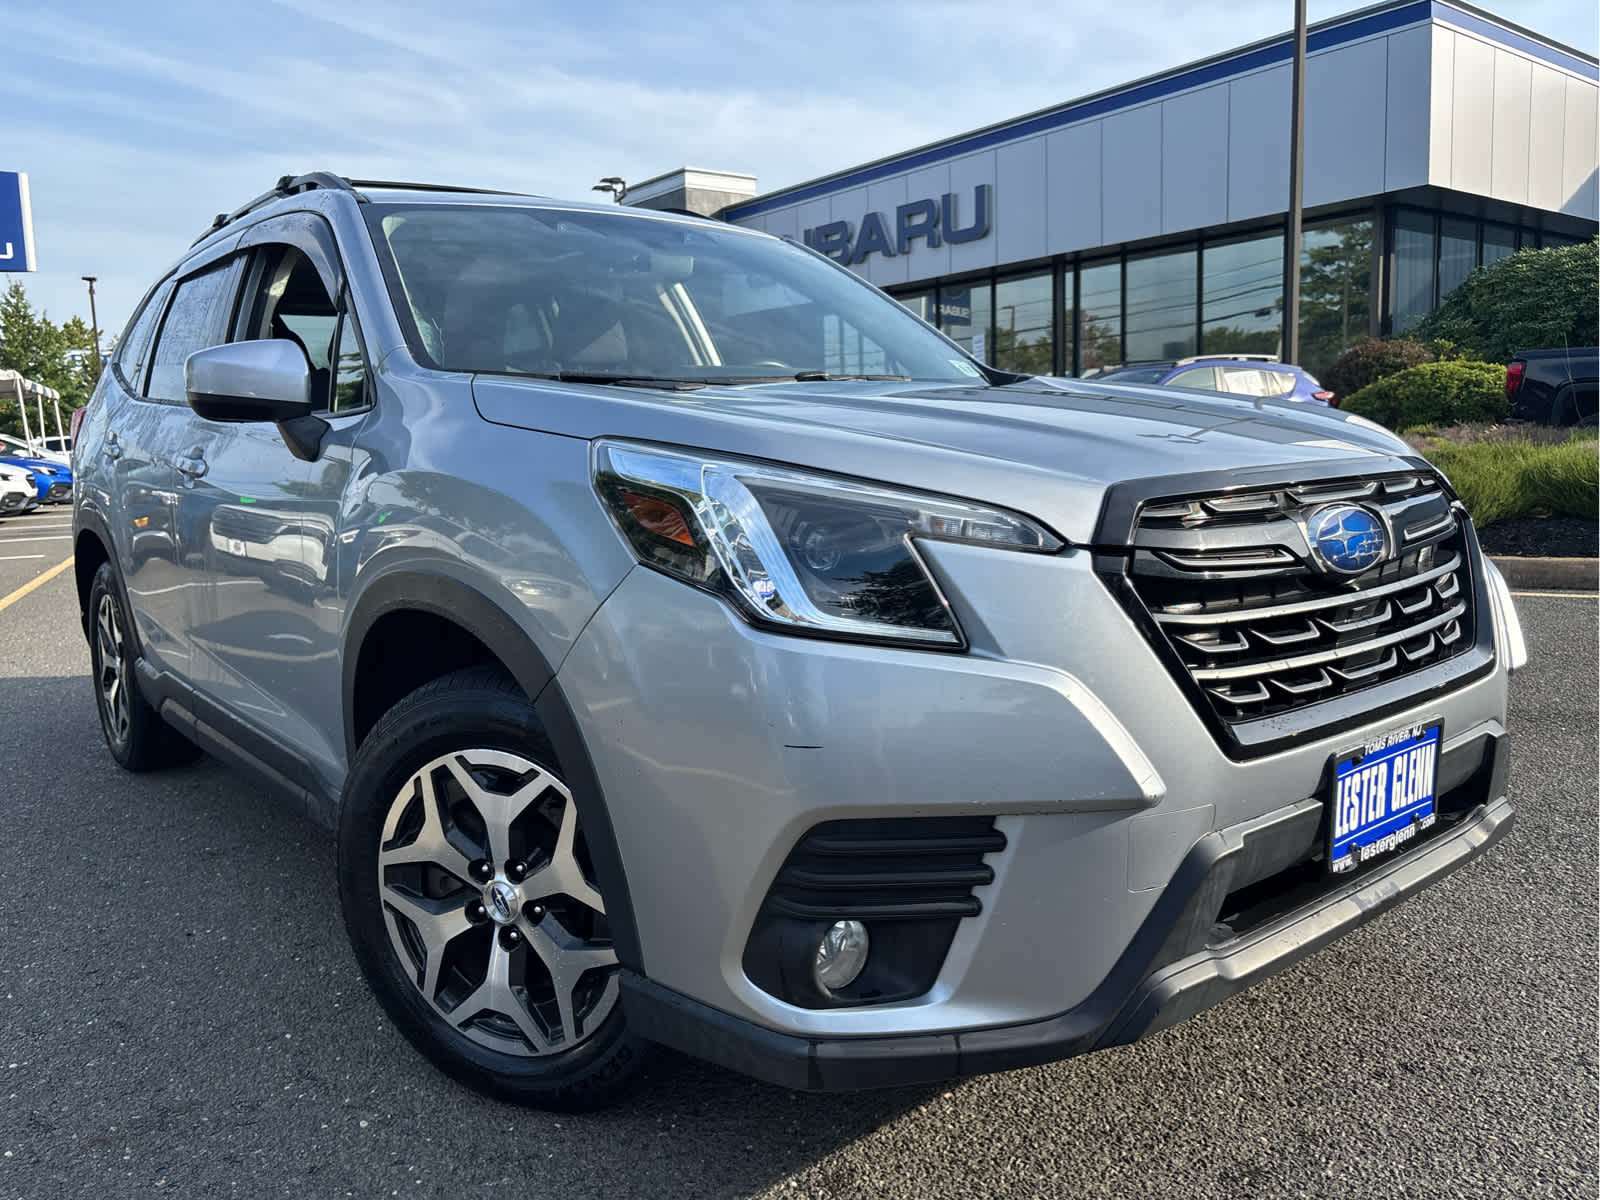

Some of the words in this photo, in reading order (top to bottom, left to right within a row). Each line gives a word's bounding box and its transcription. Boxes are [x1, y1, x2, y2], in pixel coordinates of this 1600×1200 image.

[804, 184, 991, 266] BARU
[1364, 738, 1386, 755] TOMS
[1411, 725, 1422, 738] NJ
[1335, 762, 1387, 838] LESTER
[1391, 743, 1436, 812] GLENN
[1360, 823, 1416, 862] lesterglenn
